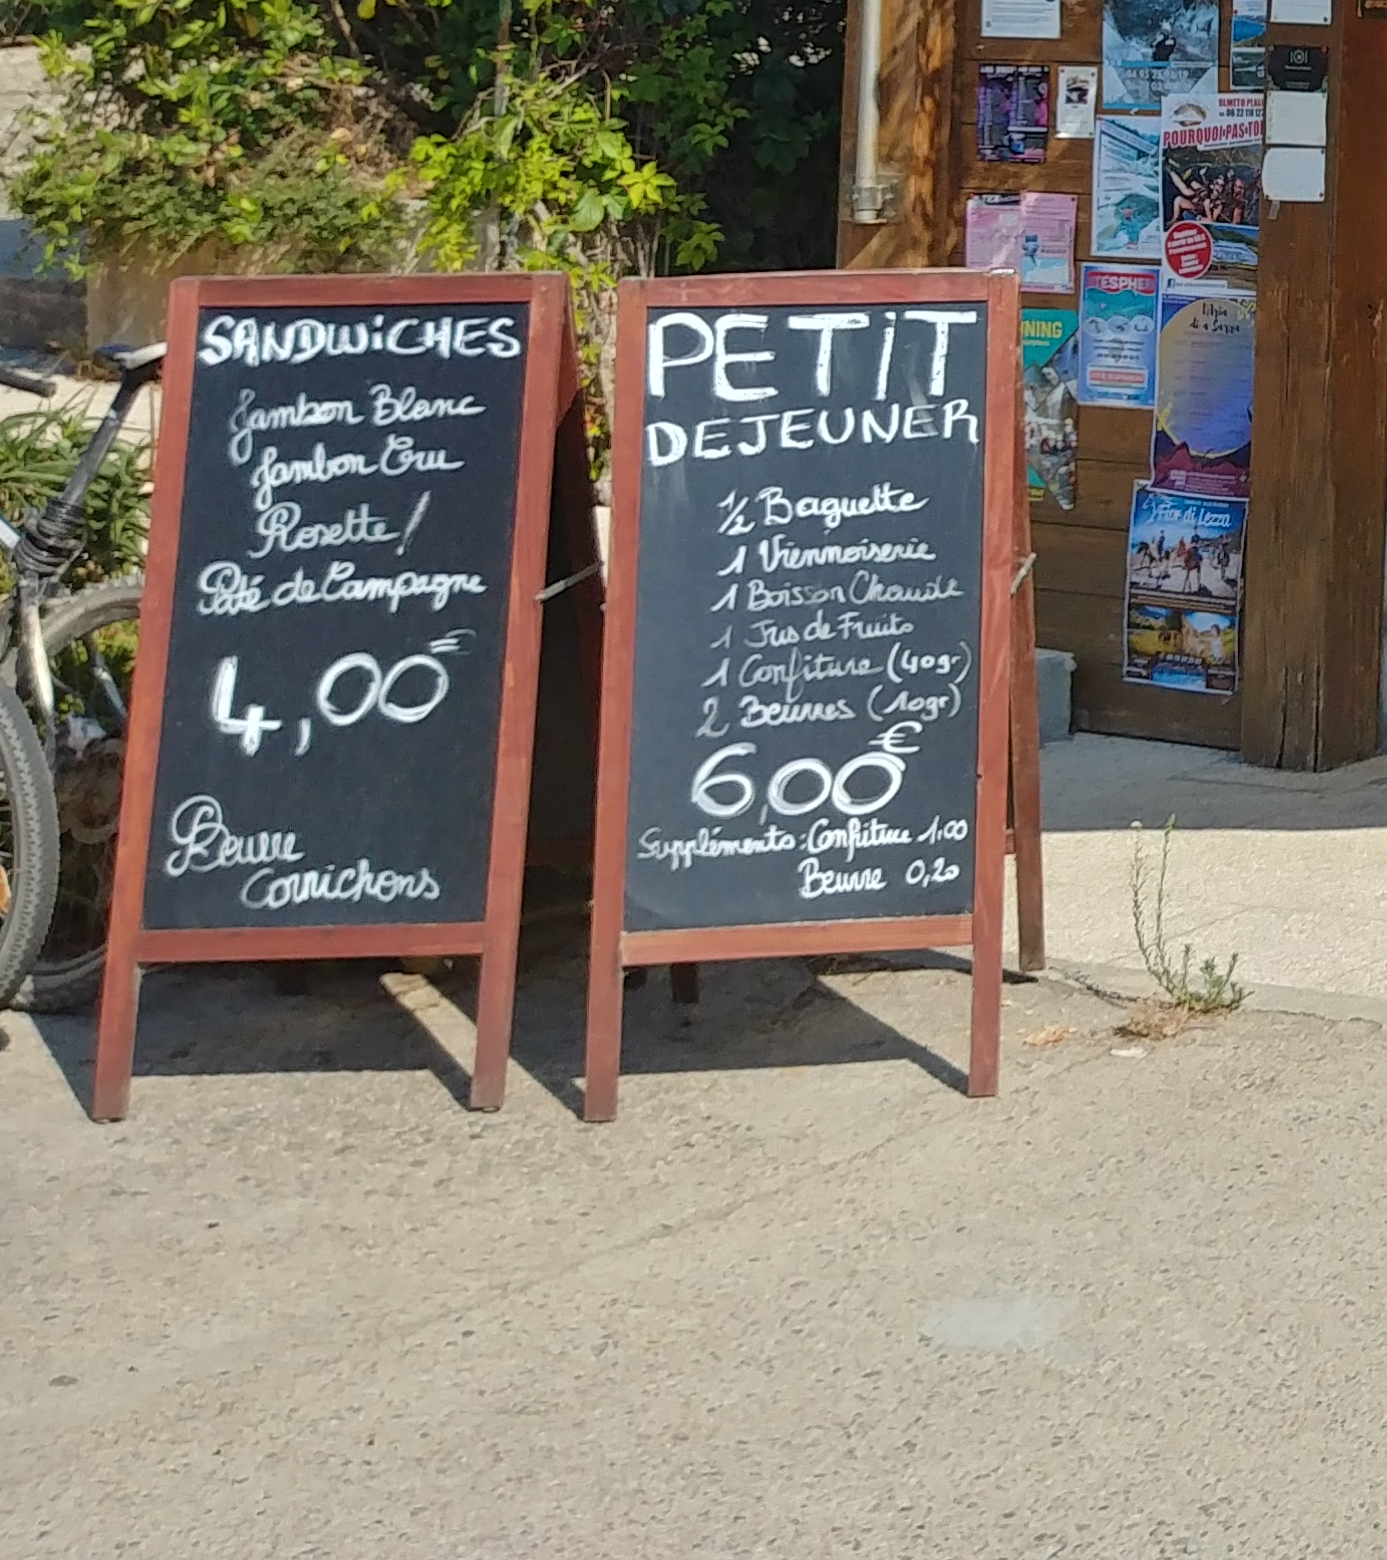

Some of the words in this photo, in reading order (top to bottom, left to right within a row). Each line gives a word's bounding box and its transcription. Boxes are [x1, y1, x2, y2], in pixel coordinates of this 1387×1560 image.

[229, 388, 363, 466] Jambon
[369, 383, 487, 428] Blanc
[645, 398, 981, 468] DEJEUNER
[251, 441, 379, 513] Jambon
[378, 433, 467, 478] Cru
[755, 481, 930, 531] Baguette
[716, 544, 746, 577] 1
[759, 531, 938, 574] Viennoiserie
[270, 567, 323, 604] de
[320, 560, 489, 615] Campagne
[710, 584, 739, 613] 1
[746, 577, 846, 610] Boisson
[848, 567, 965, 605] Chaude
[743, 620, 801, 648] Jus
[803, 608, 838, 640] de
[837, 612, 915, 642] Fruits
[738, 646, 884, 704] Confiture
[740, 694, 857, 729] Beurres
[241, 857, 441, 910] Cornichons
[798, 858, 888, 900] Beurre
[904, 858, 961, 889] 0,20
